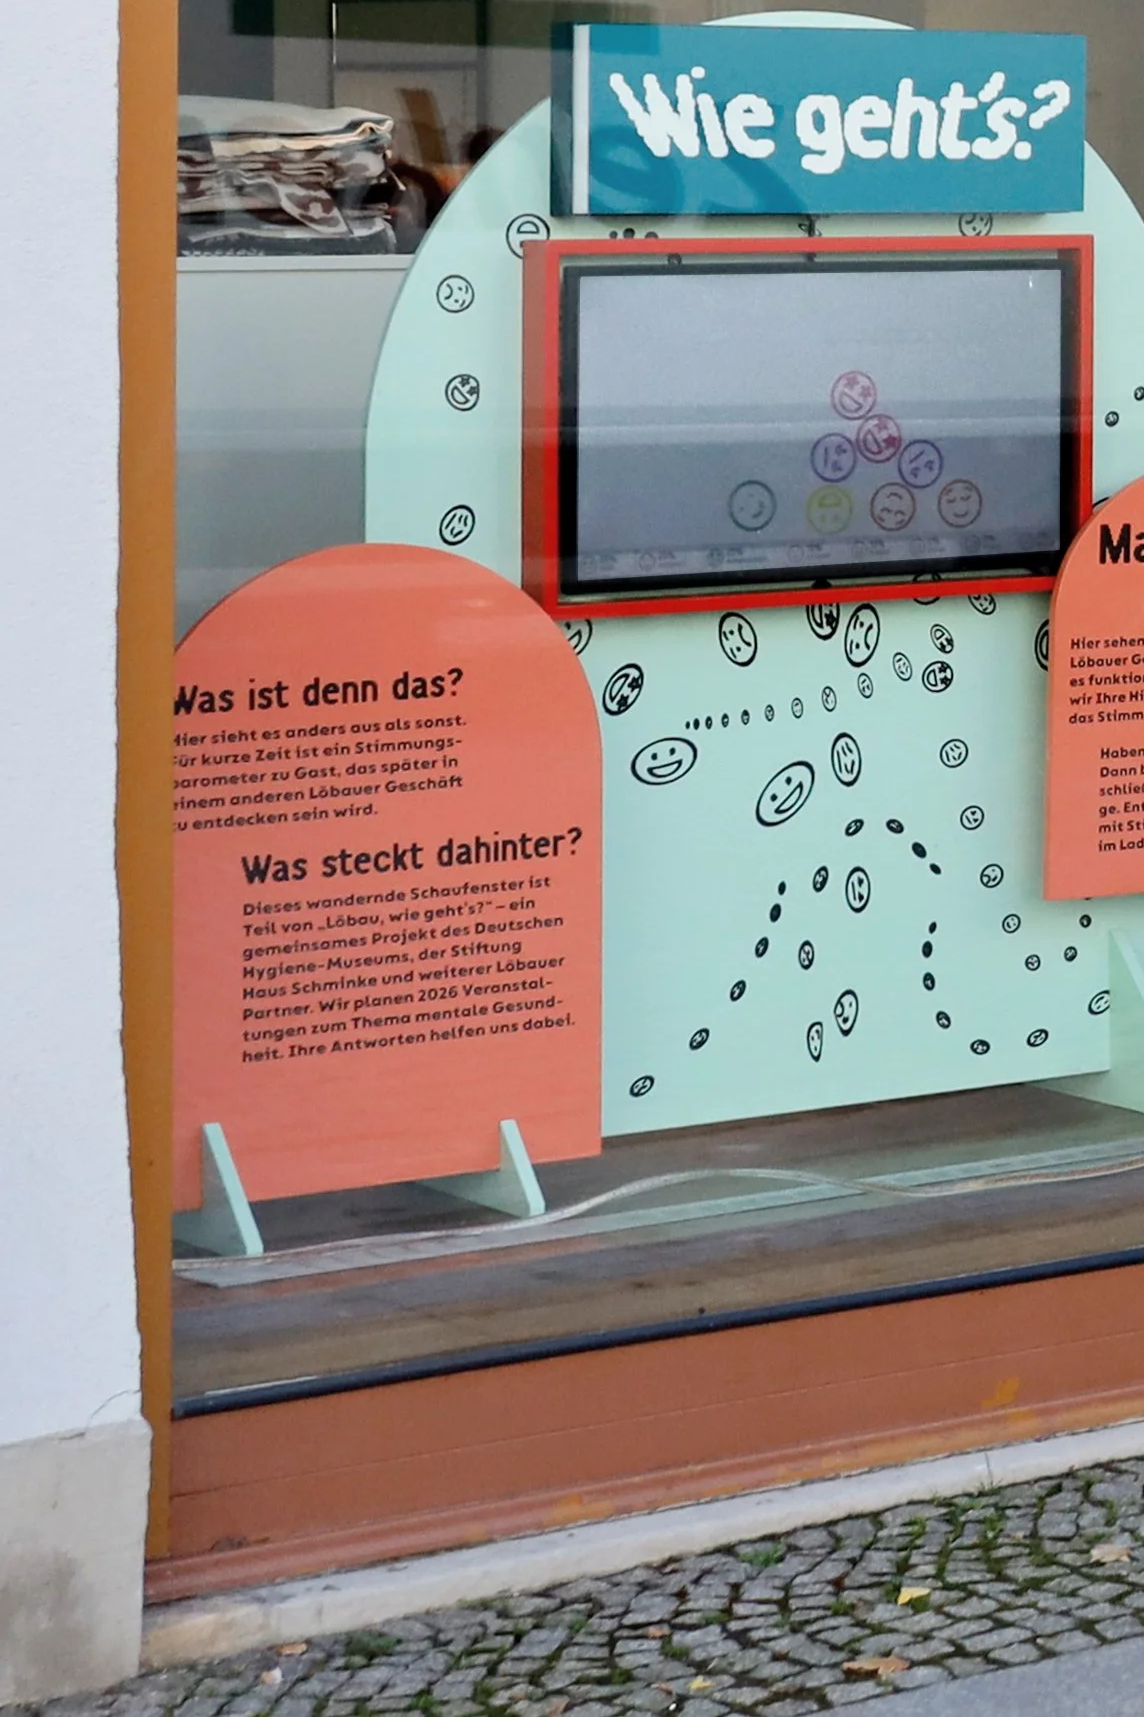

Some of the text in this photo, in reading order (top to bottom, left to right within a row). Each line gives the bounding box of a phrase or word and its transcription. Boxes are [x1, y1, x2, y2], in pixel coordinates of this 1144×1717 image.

[609, 66, 1071, 175] Wie geht's?
[1070, 637, 1100, 649] Hier
[1104, 636, 1144, 648] sehen
[1070, 656, 1128, 668] Löbauer
[175, 667, 464, 715] Was ist denn das?
[1069, 677, 1084, 687] es
[1069, 692, 1092, 705] wir
[1095, 692, 1126, 704] Ihre
[211, 729, 257, 744] sieht
[261, 729, 280, 740] es
[285, 724, 345, 738] anders
[350, 722, 380, 733] aus
[385, 718, 410, 731] als
[415, 715, 467, 729] sonst.
[1068, 712, 1093, 724] das
[175, 737, 461, 767] ür kurze Zeit ist ein Stimmungs-
[271, 771, 289, 781] zu
[294, 766, 341, 779] Gast,
[345, 763, 376, 775] das
[381, 759, 437, 774] später
[442, 754, 457, 767] in
[1100, 766, 1137, 777] Dann
[229, 790, 304, 805] anderen
[309, 784, 380, 799] Löbauer
[384, 775, 463, 793] Geschäft
[192, 812, 288, 830] entdecken
[292, 806, 328, 821] sein
[333, 803, 376, 817] wird.
[1098, 805, 1119, 818] ge.
[1098, 820, 1123, 833] mit
[241, 826, 582, 884] Was steckt dahinter?
[1098, 840, 1116, 851] im
[243, 875, 551, 916] Dieses wandernde Schaufenster ist
[242, 921, 276, 937] Teil
[281, 921, 313, 933] von
[388, 908, 420, 922] wie
[509, 896, 535, 910] ein
[242, 916, 563, 961] gemeinsames Projekt des Deutschen
[242, 941, 521, 981] Hygiene-Museums, der Stiftung
[242, 957, 564, 1000] Haus Schminke und weiterer Löbauer
[242, 976, 552, 1021] Partner. Wir planen 2026 Veranstal-
[242, 995, 564, 1042] tungen zum Thema mentale Gesund-
[242, 1012, 576, 1062] heit. Ihre Antworten helfen uns dabei.
